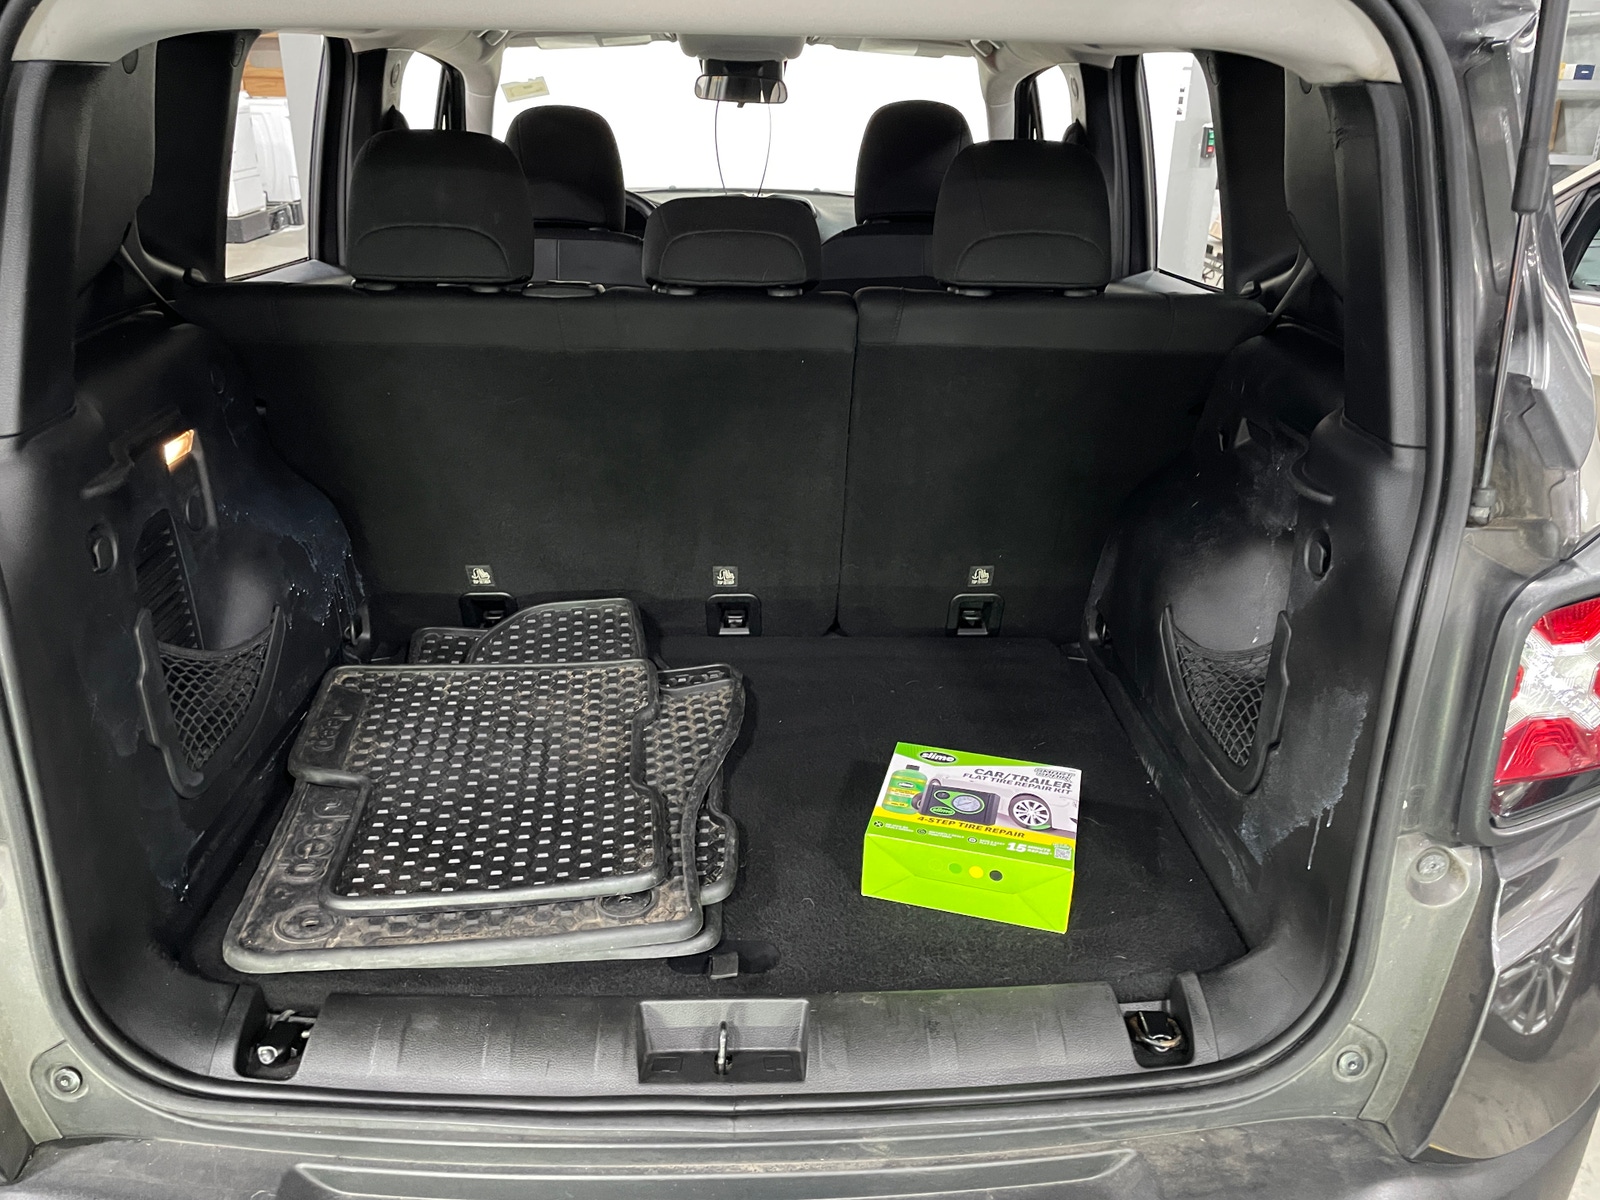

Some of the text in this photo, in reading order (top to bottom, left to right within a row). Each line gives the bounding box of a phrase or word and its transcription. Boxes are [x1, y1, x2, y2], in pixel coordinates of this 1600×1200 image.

[920, 752, 955, 763] slime
[962, 772, 1073, 795] FLAT TIRE REPAIR KIT
[974, 767, 1073, 790] CAR/TRAILER
[917, 816, 1026, 839] 4-STEP TIRE REPAIR
[1006, 842, 1028, 853] 15
